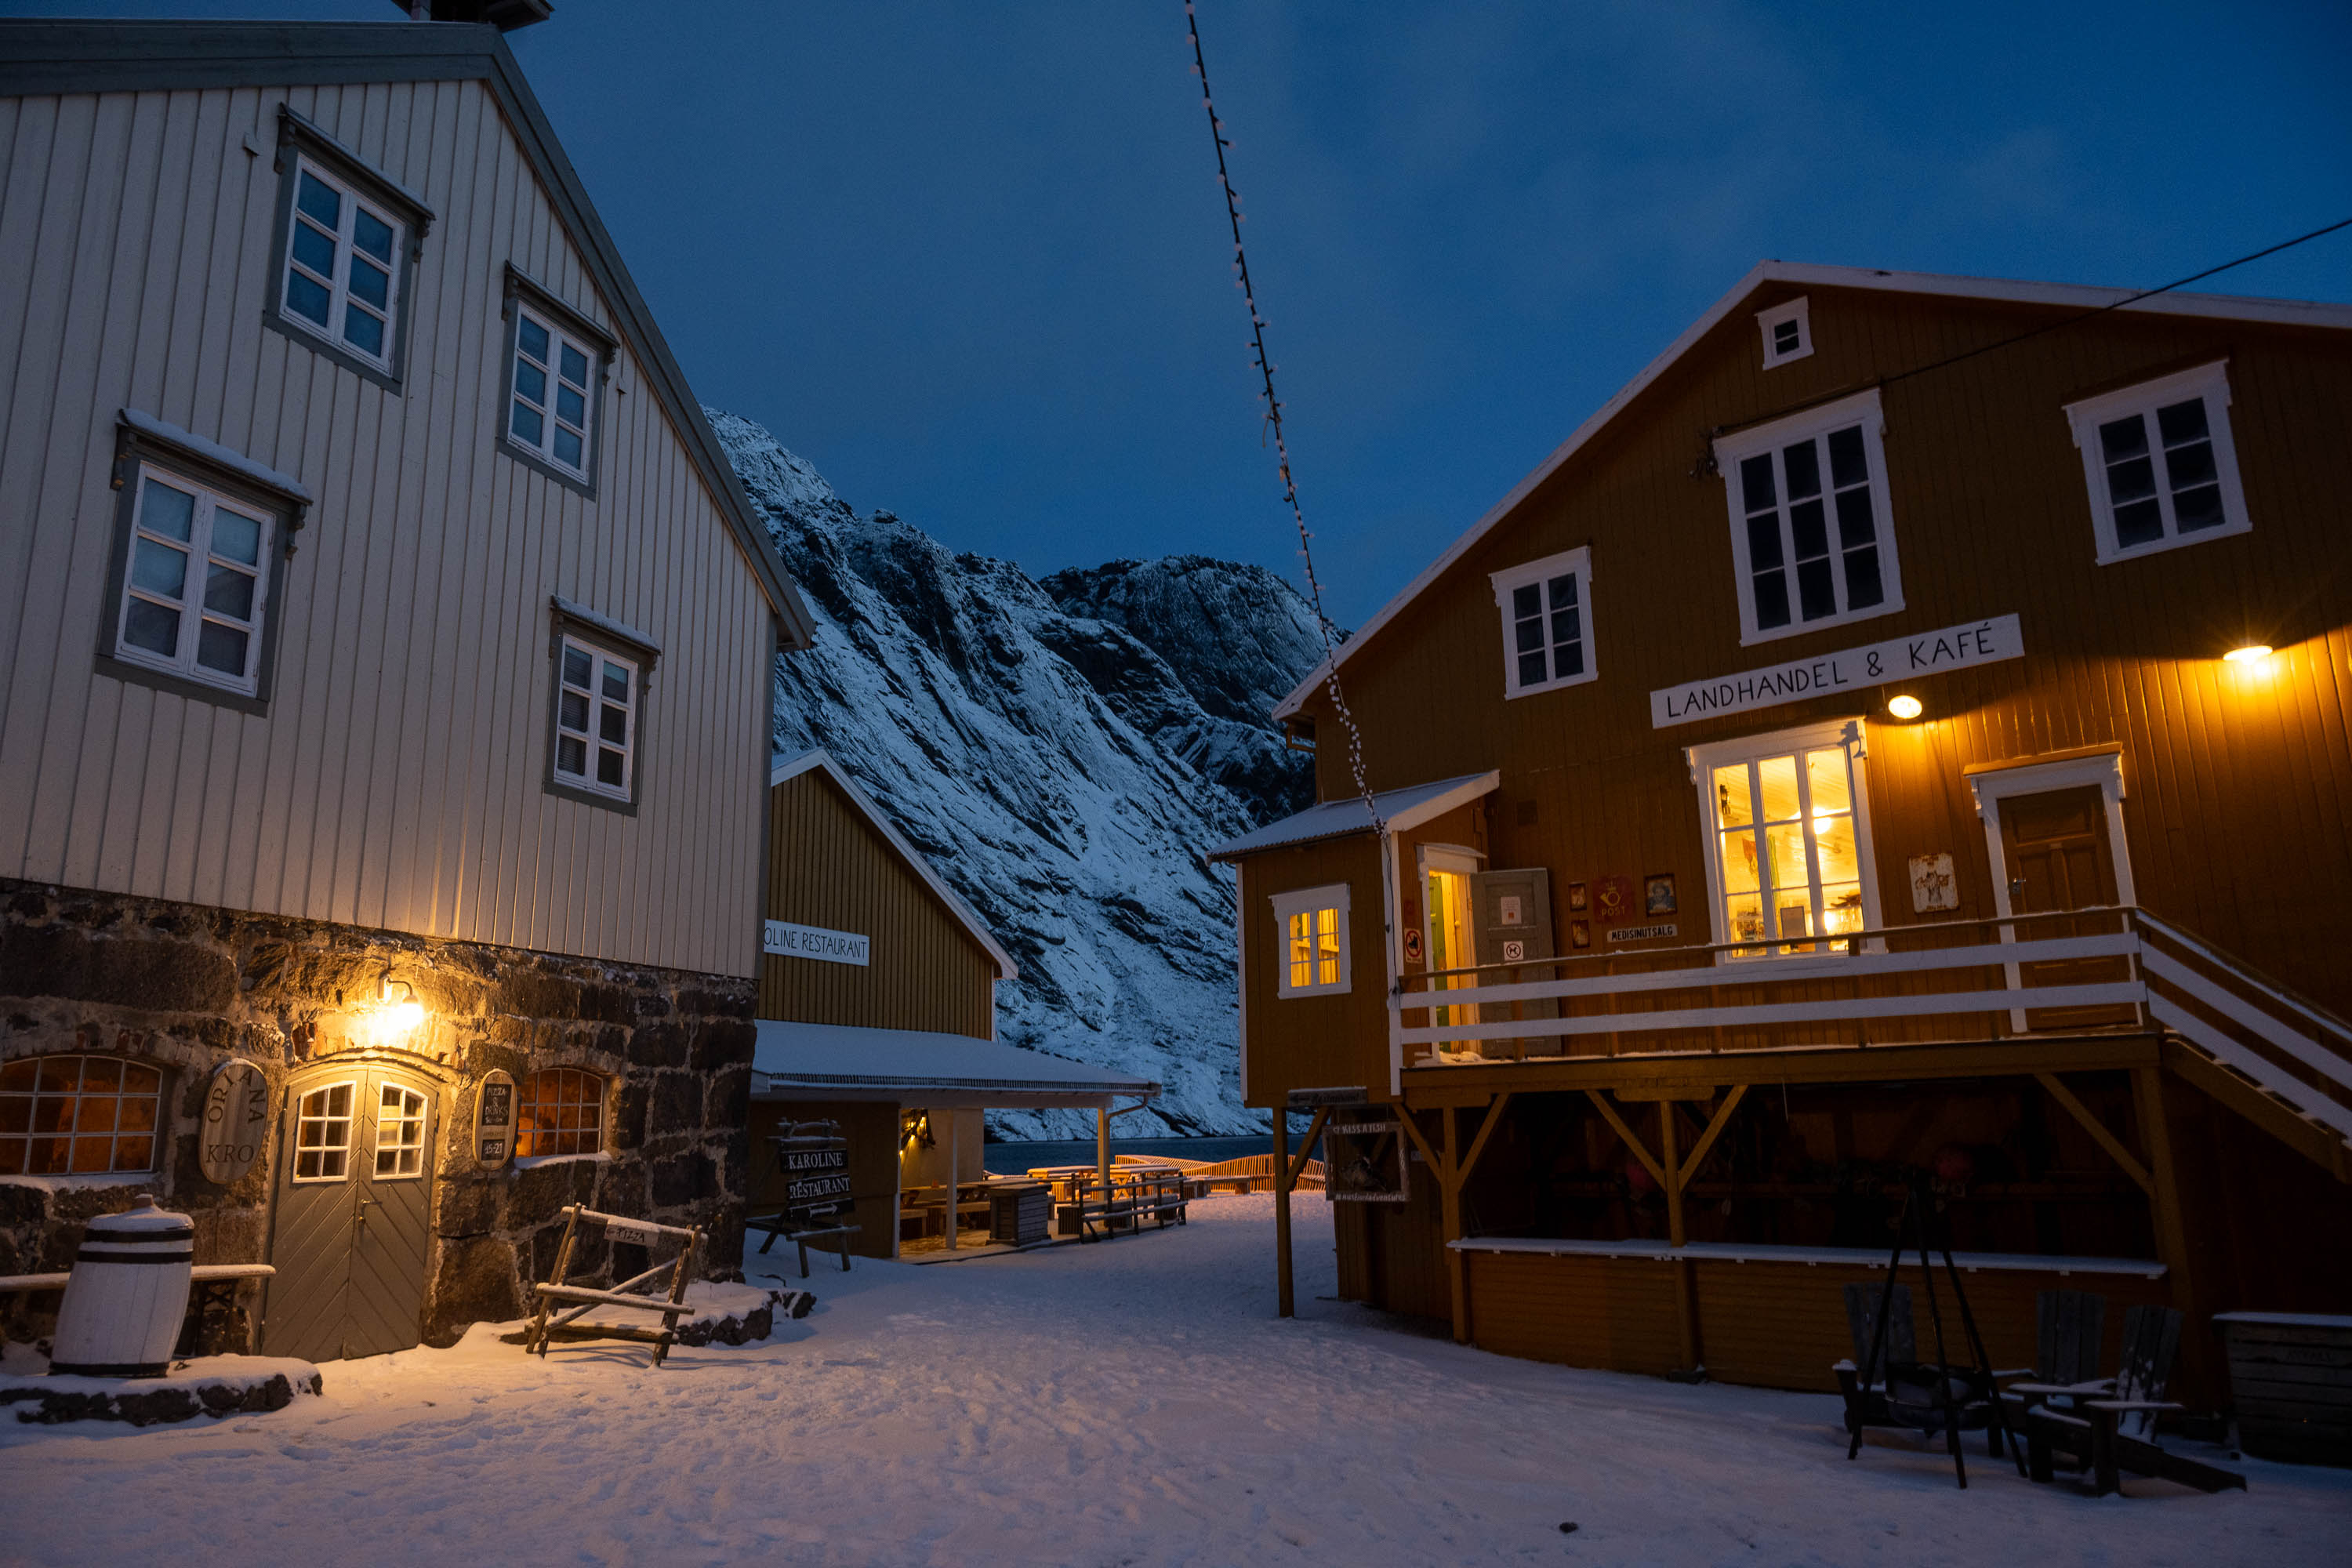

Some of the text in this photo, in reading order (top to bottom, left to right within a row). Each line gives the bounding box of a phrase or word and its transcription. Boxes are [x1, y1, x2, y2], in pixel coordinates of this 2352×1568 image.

[1667, 621, 1995, 718] LANDHANDEL & KAFÉ
[1611, 926, 1674, 942] MEDISINUTSALG
[801, 932, 867, 959] RESTAURANT
[208, 1069, 265, 1124] ORIANA
[487, 1087, 506, 1096] PIZZA
[485, 1106, 509, 1117] DRINKS
[206, 1145, 255, 1163] KRO
[789, 1152, 843, 1170] KAROLINE
[789, 1178, 850, 1199] RESTAURANT
